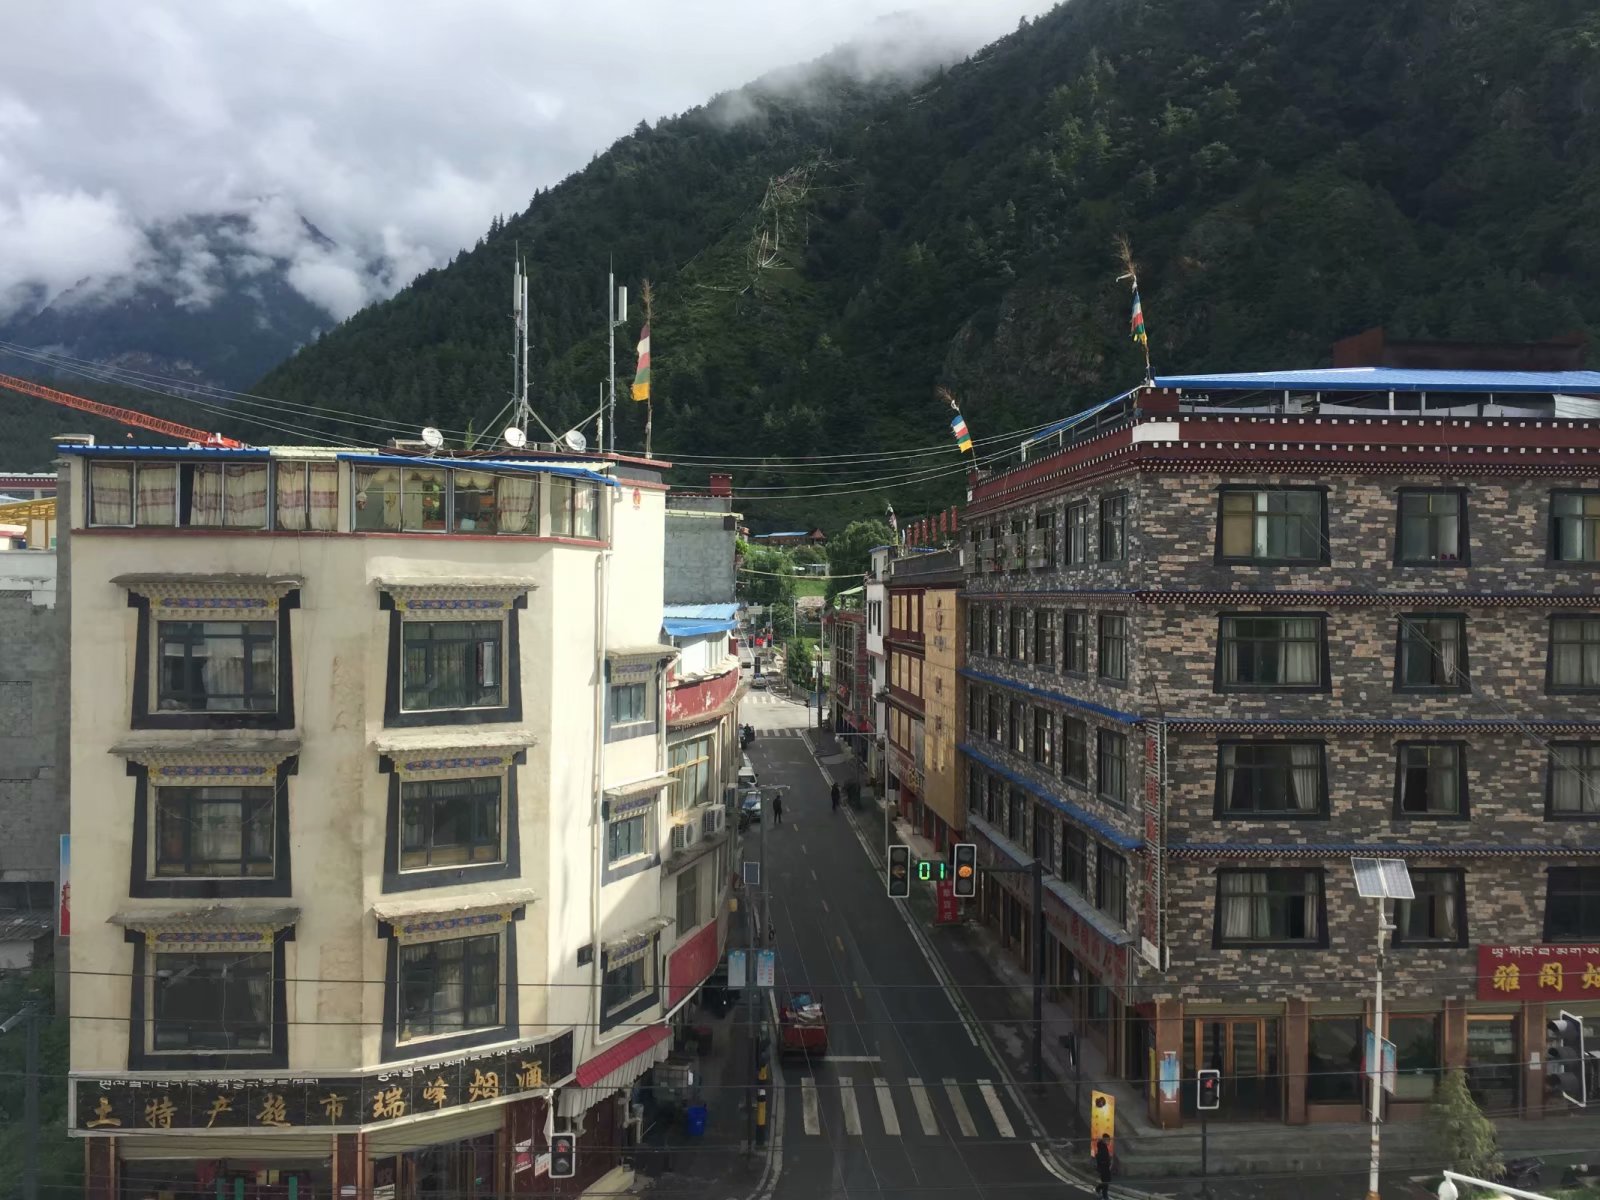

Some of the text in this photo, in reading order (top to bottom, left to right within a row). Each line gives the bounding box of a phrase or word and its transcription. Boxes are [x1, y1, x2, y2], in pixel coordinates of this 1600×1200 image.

[919, 862, 945, 880] 01
[373, 1060, 547, 1119] 瑞峰烟酒
[86, 1093, 348, 1129] 土特产超市
